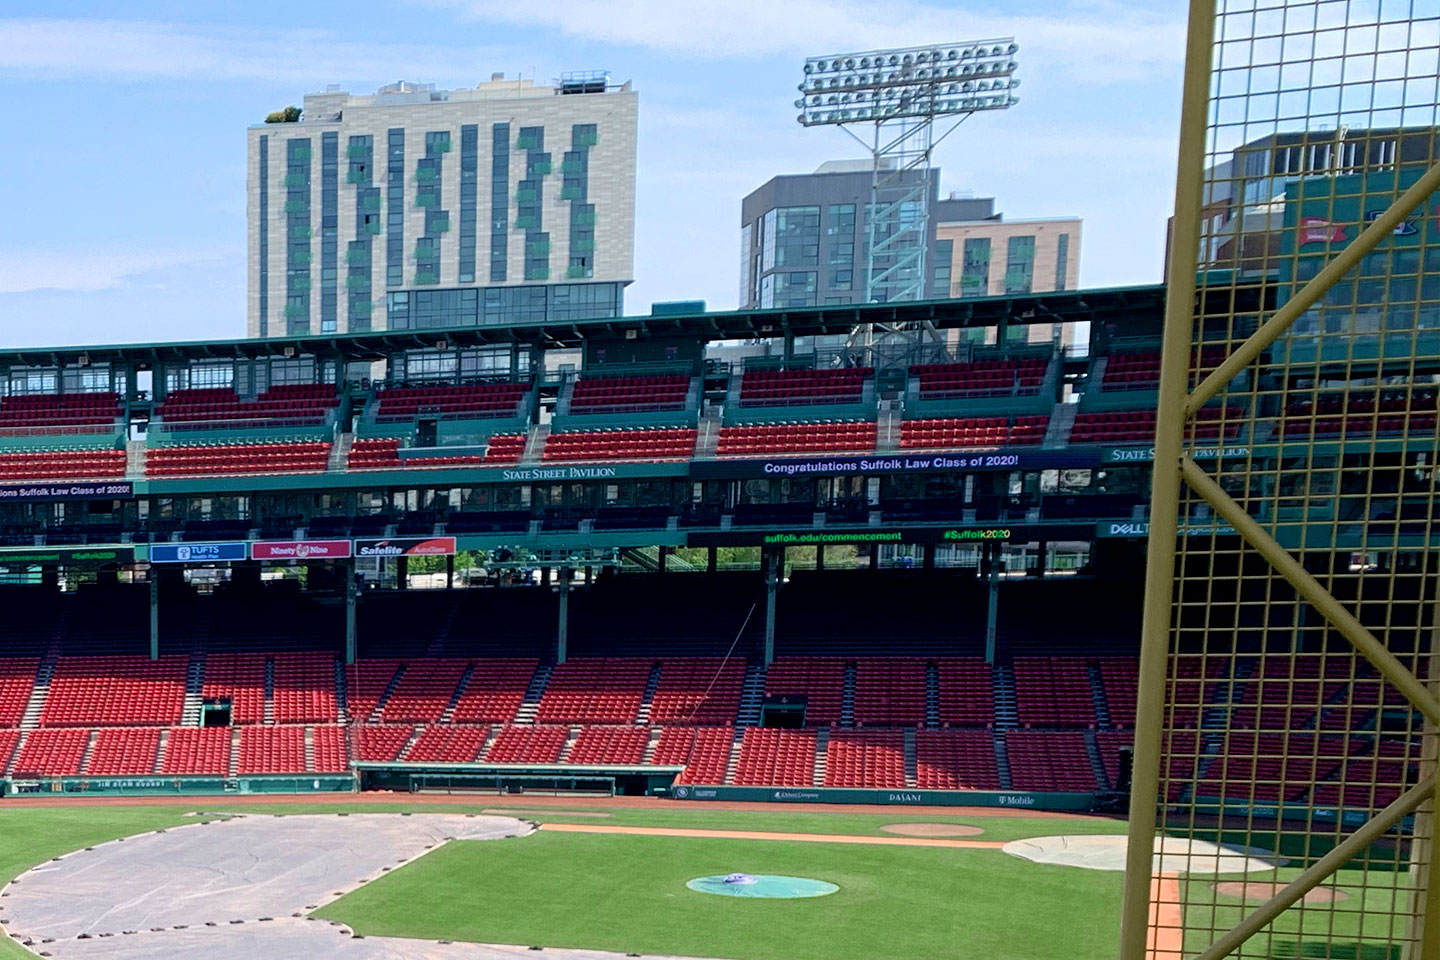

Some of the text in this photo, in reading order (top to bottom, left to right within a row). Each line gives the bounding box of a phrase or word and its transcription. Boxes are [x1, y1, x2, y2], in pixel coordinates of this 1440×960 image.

[1112, 449, 1147, 460] STATE
[764, 455, 1019, 474] Congratulations Suffolk Law Class of 2020!
[503, 467, 616, 480] STATE STREET PAVILION
[19, 488, 49, 497] Suffolk
[51, 487, 69, 496] Law
[70, 486, 94, 495] Class
[96, 486, 105, 494] of
[106, 485, 130, 494] 2020!
[1110, 523, 1144, 535] DELL
[764, 529, 1011, 543] suffolk.edu/commencement #Suffolk2020
[191, 545, 219, 554] TUFTS
[270, 545, 328, 557] Ninety Nine
[360, 546, 403, 556] Safelite
[889, 793, 921, 801] DASANI
[1007, 796, 1035, 805] Mobile
